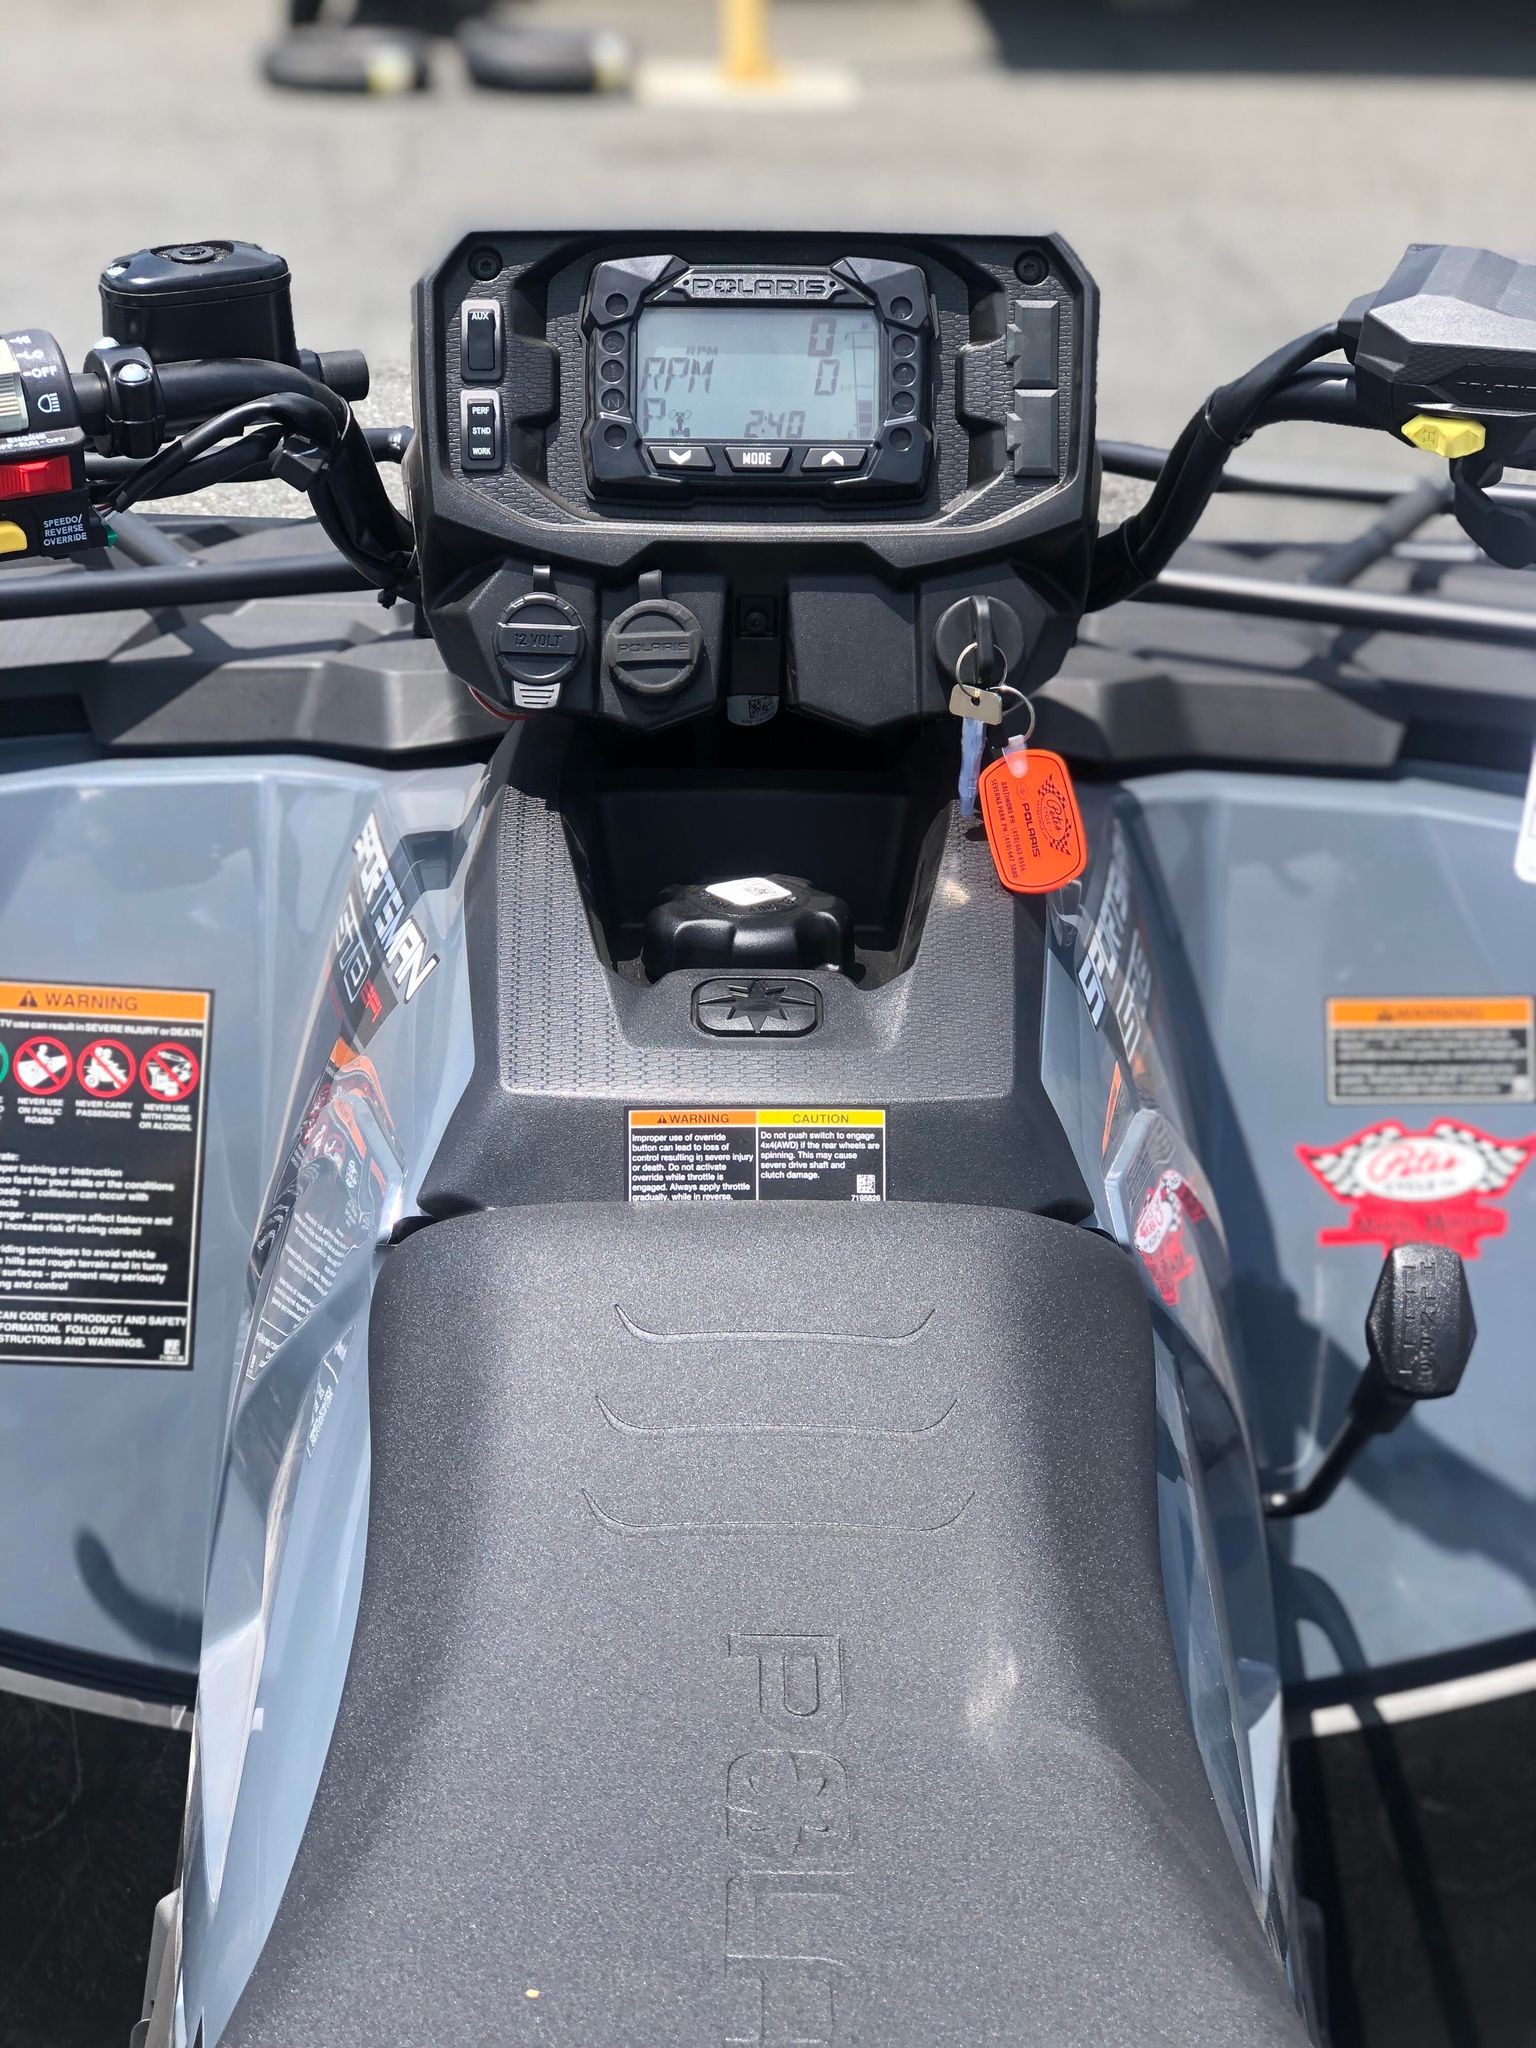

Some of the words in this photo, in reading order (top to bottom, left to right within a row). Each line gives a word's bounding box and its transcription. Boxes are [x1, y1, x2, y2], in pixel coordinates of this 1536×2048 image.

[692, 278, 827, 295] POLARIS
[471, 312, 490, 321] AUX
[686, 346, 718, 355] RPM
[31, 366, 57, 379] OFF
[642, 357, 713, 394] RPM
[471, 406, 490, 415] PERF
[471, 427, 491, 435] STND
[6, 433, 47, 444] ENGINE
[471, 447, 491, 456] WORK
[742, 452, 772, 465] MODE
[43, 513, 83, 528] SPEEDO/
[44, 523, 84, 538] REVERSE
[43, 532, 87, 547] OVERRIDE
[513, 633, 528, 648] 12
[530, 634, 563, 649] VOLT
[617, 640, 690, 653] POLARIS
[1022, 803, 1041, 858] POLARIS
[352, 810, 440, 1004] SPORTSMAN
[335, 892, 372, 1003] 570
[44, 992, 139, 1012] WARNING
[30, 1021, 48, 1030] can
[48, 1021, 75, 1031] result
[75, 1022, 85, 1031] in
[85, 1022, 123, 1033] SEVERE
[124, 1024, 159, 1036] INJURY
[160, 1027, 170, 1036] or
[170, 1027, 203, 1037] DEATH
[17, 1097, 46, 1106] NEVER
[47, 1098, 64, 1107] USE
[75, 1099, 103, 1108] NEVER
[104, 1101, 133, 1110] CARRY
[18, 1106, 31, 1114] ON
[32, 1107, 62, 1116] PUBLIC
[75, 1108, 132, 1119] PASSENGERS
[144, 1103, 172, 1112] NEVER
[173, 1104, 190, 1113] USE
[24, 1115, 55, 1125] ROADS
[140, 1112, 162, 1121] WITH
[162, 1113, 192, 1122] DRUGS
[669, 1113, 730, 1124] WARNING
[792, 1113, 849, 1124] CAUTION
[138, 1121, 152, 1129] OR
[153, 1122, 193, 1132] ALCOHOL
[631, 1133, 668, 1143] Improper
[684, 1133, 694, 1141] of
[694, 1133, 727, 1141] override
[760, 1131, 772, 1139] Do
[773, 1131, 787, 1139] not
[788, 1131, 808, 1141] push
[809, 1131, 835, 1139] switch
[836, 1131, 845, 1139] to
[846, 1133, 875, 1141] engage
[631, 1143, 657, 1152] button
[674, 1143, 692, 1151] lead
[693, 1143, 702, 1151] to
[703, 1143, 720, 1151] loss
[721, 1142, 730, 1151] of
[760, 1141, 799, 1150] 4x4(AWD)
[800, 1141, 806, 1149] if
[806, 1141, 820, 1149] the
[838, 1141, 866, 1149] wheels
[631, 1153, 660, 1162] control
[660, 1153, 694, 1163] resulting
[695, 1153, 703, 1161] in
[732, 1152, 754, 1163] injury
[760, 1151, 796, 1160] spinning.
[797, 1151, 815, 1159] This
[20, 1164, 57, 1176] training
[59, 1167, 70, 1175] or
[71, 1166, 123, 1177] instruction
[641, 1163, 667, 1171] death.
[668, 1163, 680, 1171] Do
[681, 1163, 695, 1171] not
[695, 1163, 727, 1171] activate
[788, 1161, 808, 1169] drive
[809, 1161, 829, 1169] shaft
[830, 1161, 846, 1169] and
[631, 1173, 664, 1181] override
[665, 1173, 686, 1181] while
[686, 1173, 716, 1181] throttle
[716, 1173, 724, 1181] is
[760, 1171, 785, 1179] clutch
[786, 1171, 820, 1180] damage.
[13, 1175, 32, 1185] fast
[33, 1176, 48, 1185] for
[48, 1177, 70, 1188] your
[94, 1180, 106, 1188] or
[107, 1180, 123, 1189] the
[124, 1181, 175, 1192] conditions
[631, 1183, 668, 1193] engaged.
[669, 1183, 698, 1192] Always
[698, 1183, 721, 1192] apply
[721, 1183, 751, 1191] throttle
[32, 1212, 87, 1223] passengers
[88, 1213, 115, 1223] affect
[116, 1214, 153, 1225] balance
[154, 1216, 174, 1226] and
[27, 1245, 80, 1257] techniques
[81, 1248, 92, 1257] to
[93, 1248, 120, 1258] avoid
[121, 1249, 157, 1260] vehicle
[2, 1268, 44, 1278] surfaces
[50, 1270, 98, 1280] pavement
[99, 1273, 120, 1283] may
[121, 1273, 166, 1285] seriously
[19, 1311, 49, 1322] CODE
[50, 1312, 72, 1322] FOR
[73, 1313, 124, 1324] PRODUCT
[124, 1315, 148, 1326] AND
[148, 1315, 188, 1327] SAFETY
[65, 1324, 110, 1335] FOLLOW
[110, 1326, 131, 1336] ALL
[64, 1336, 87, 1346] AND
[87, 1337, 147, 1349] WARNINGS.
